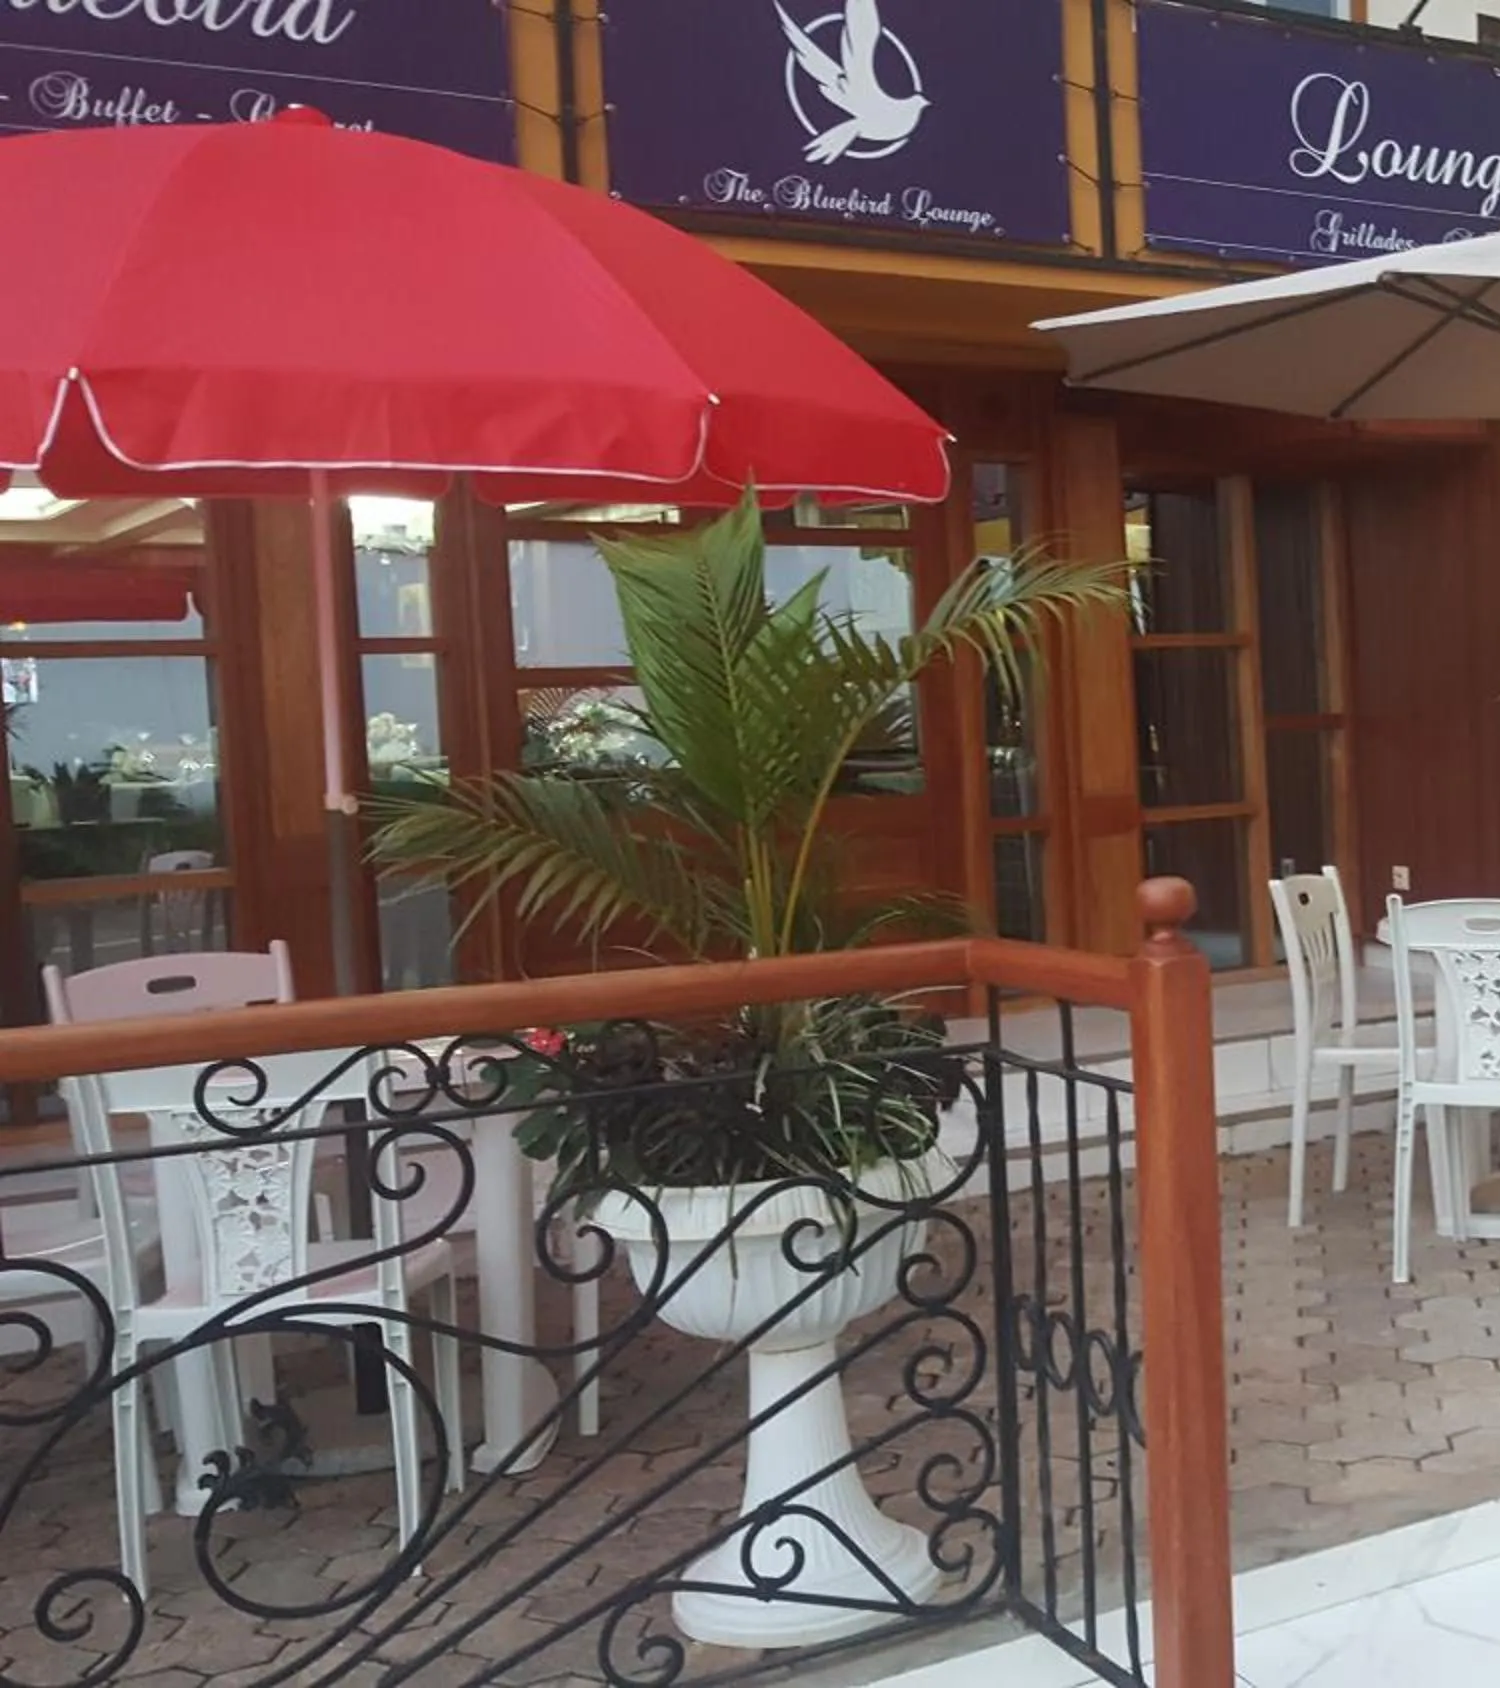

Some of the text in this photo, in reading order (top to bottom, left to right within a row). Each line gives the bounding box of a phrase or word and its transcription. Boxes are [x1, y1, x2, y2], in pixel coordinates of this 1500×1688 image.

[29, 70, 181, 128] Buffet
[703, 167, 997, 233] The Bluebird Lounge
[1310, 209, 1419, 252] Grillades
